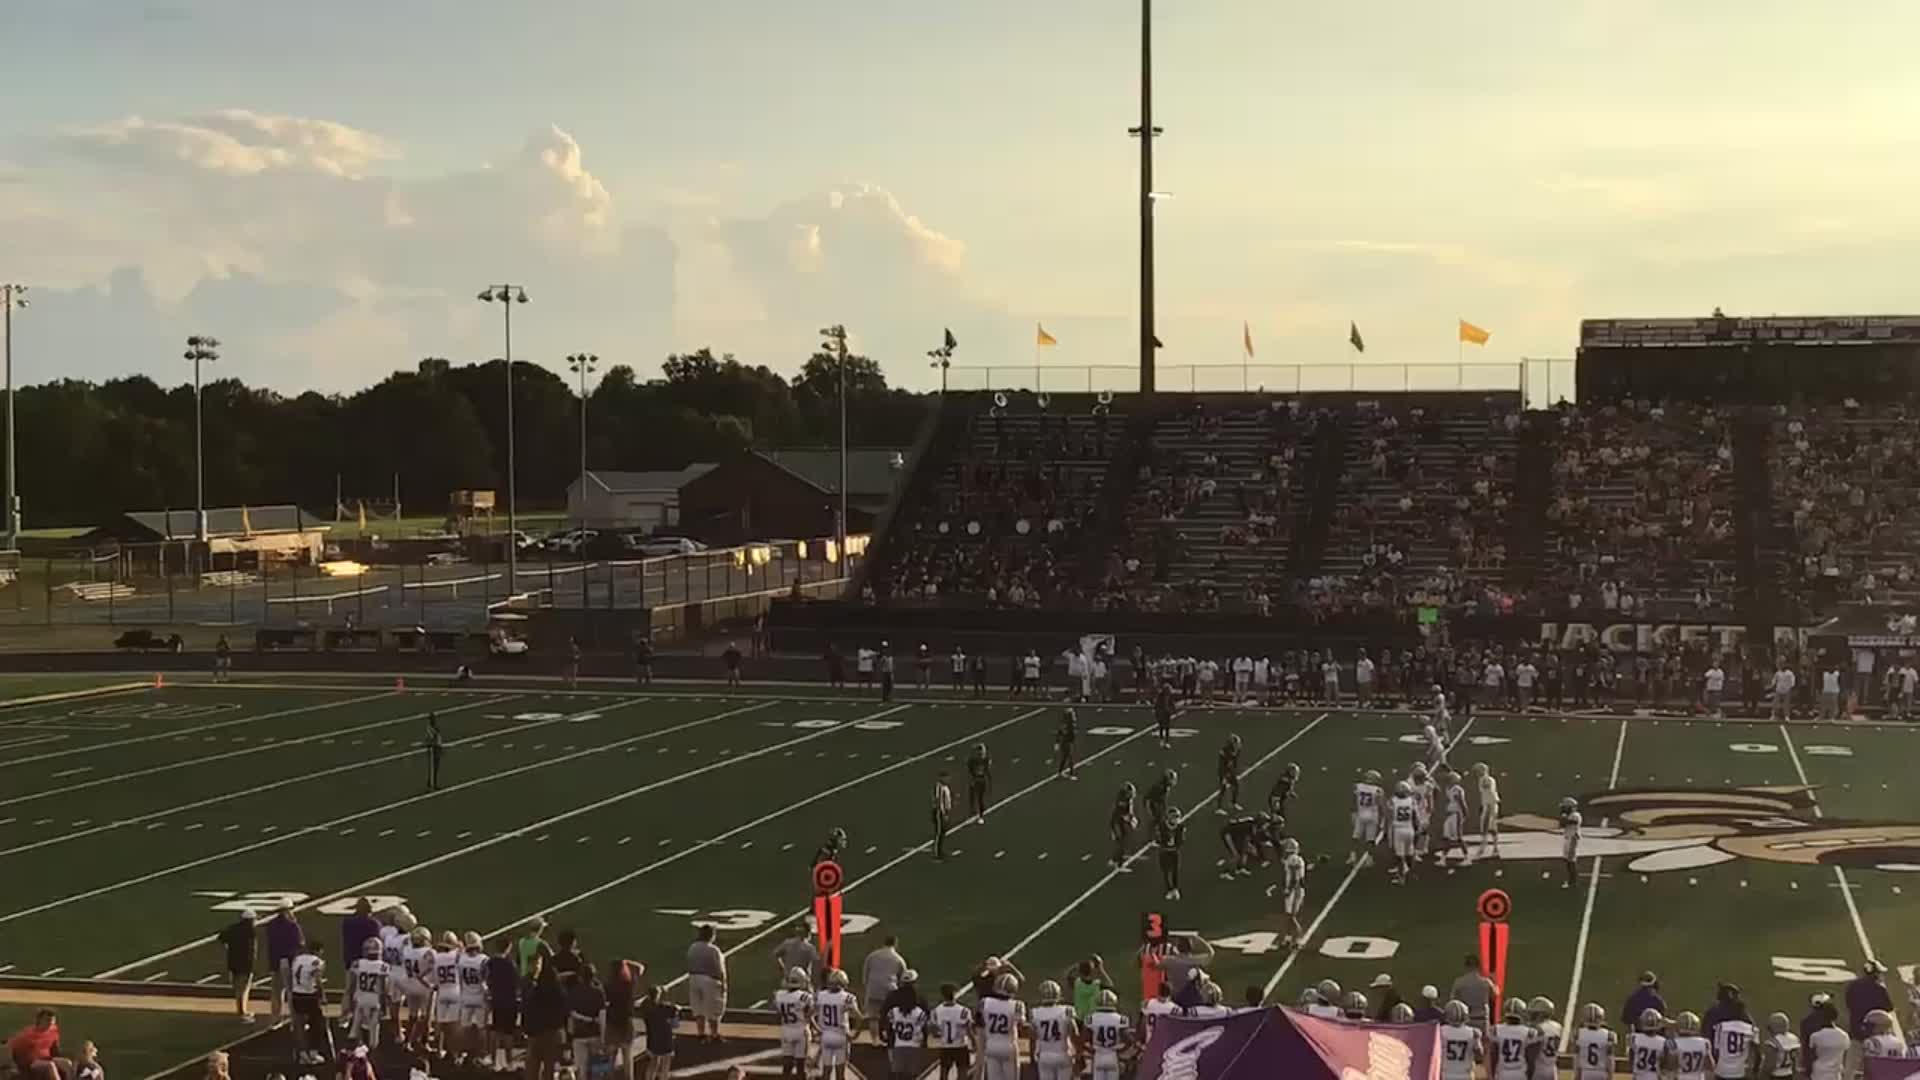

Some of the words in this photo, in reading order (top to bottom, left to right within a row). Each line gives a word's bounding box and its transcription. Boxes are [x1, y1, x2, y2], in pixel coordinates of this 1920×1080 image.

[1149, 913, 1163, 937] 3
[780, 1003, 799, 1025] 15
[823, 1004, 840, 1027] 91
[988, 1013, 1010, 1035] 72
[946, 1021, 953, 1044] 1
[1040, 1019, 1061, 1042] 74
[1097, 1025, 1117, 1048] 49
[1447, 1039, 1468, 1061] 57
[1501, 1038, 1522, 1063] 47
[1587, 1043, 1600, 1066] 6
[1727, 1031, 1744, 1055] 81
[1636, 1048, 1657, 1073] 34
[1682, 1051, 1703, 1073] 37
